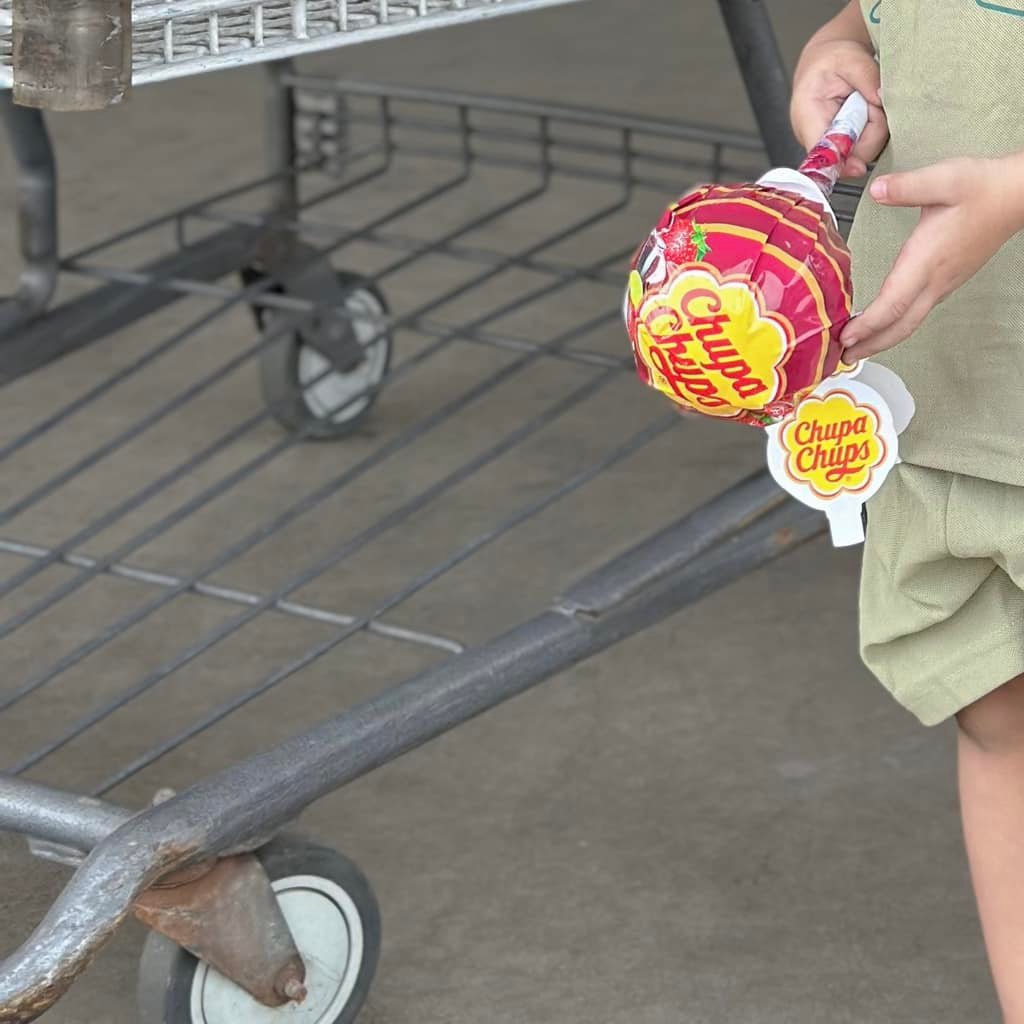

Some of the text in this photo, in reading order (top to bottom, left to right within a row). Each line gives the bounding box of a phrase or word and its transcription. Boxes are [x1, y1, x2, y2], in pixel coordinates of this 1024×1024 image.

[645, 306, 731, 407] Chups
[681, 288, 768, 399] Chupa
[795, 416, 867, 445] Chupa
[796, 440, 870, 482] Chups
